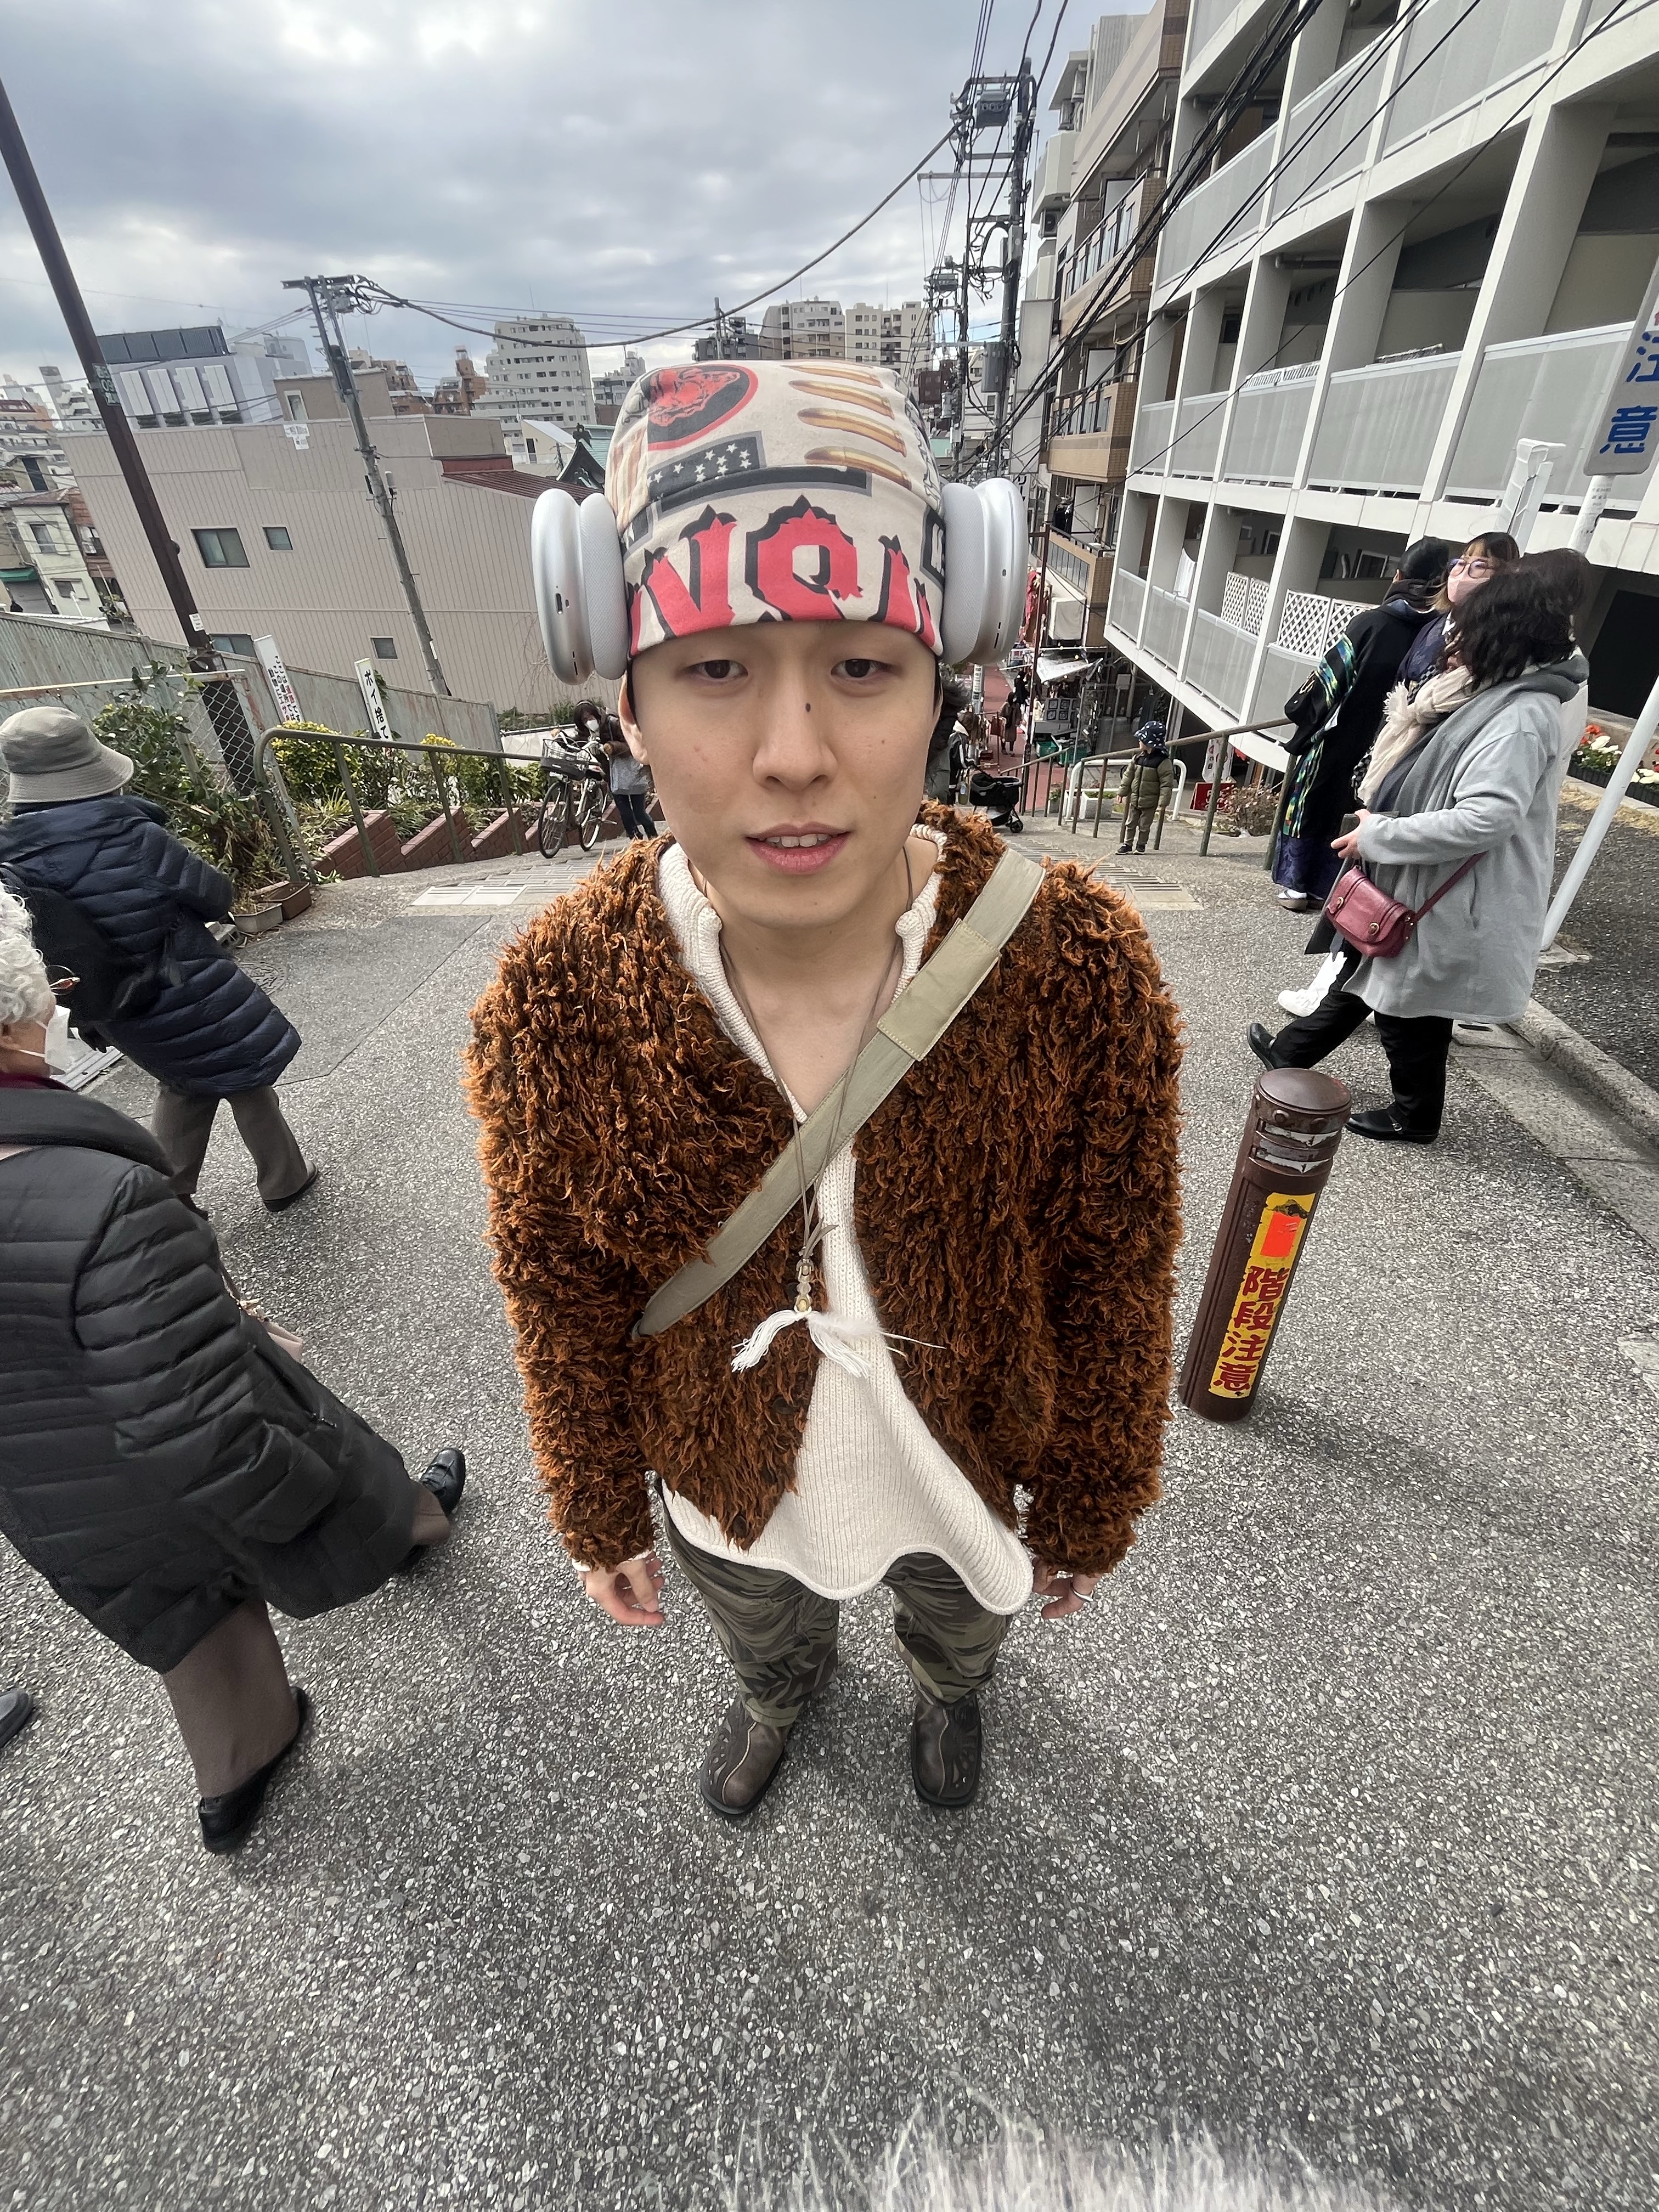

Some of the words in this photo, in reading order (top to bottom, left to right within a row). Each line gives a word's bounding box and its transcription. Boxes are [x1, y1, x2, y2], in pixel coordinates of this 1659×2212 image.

[364, 669, 389, 739] ポイ捨て
[1212, 1265, 1290, 1392] 階段注意
